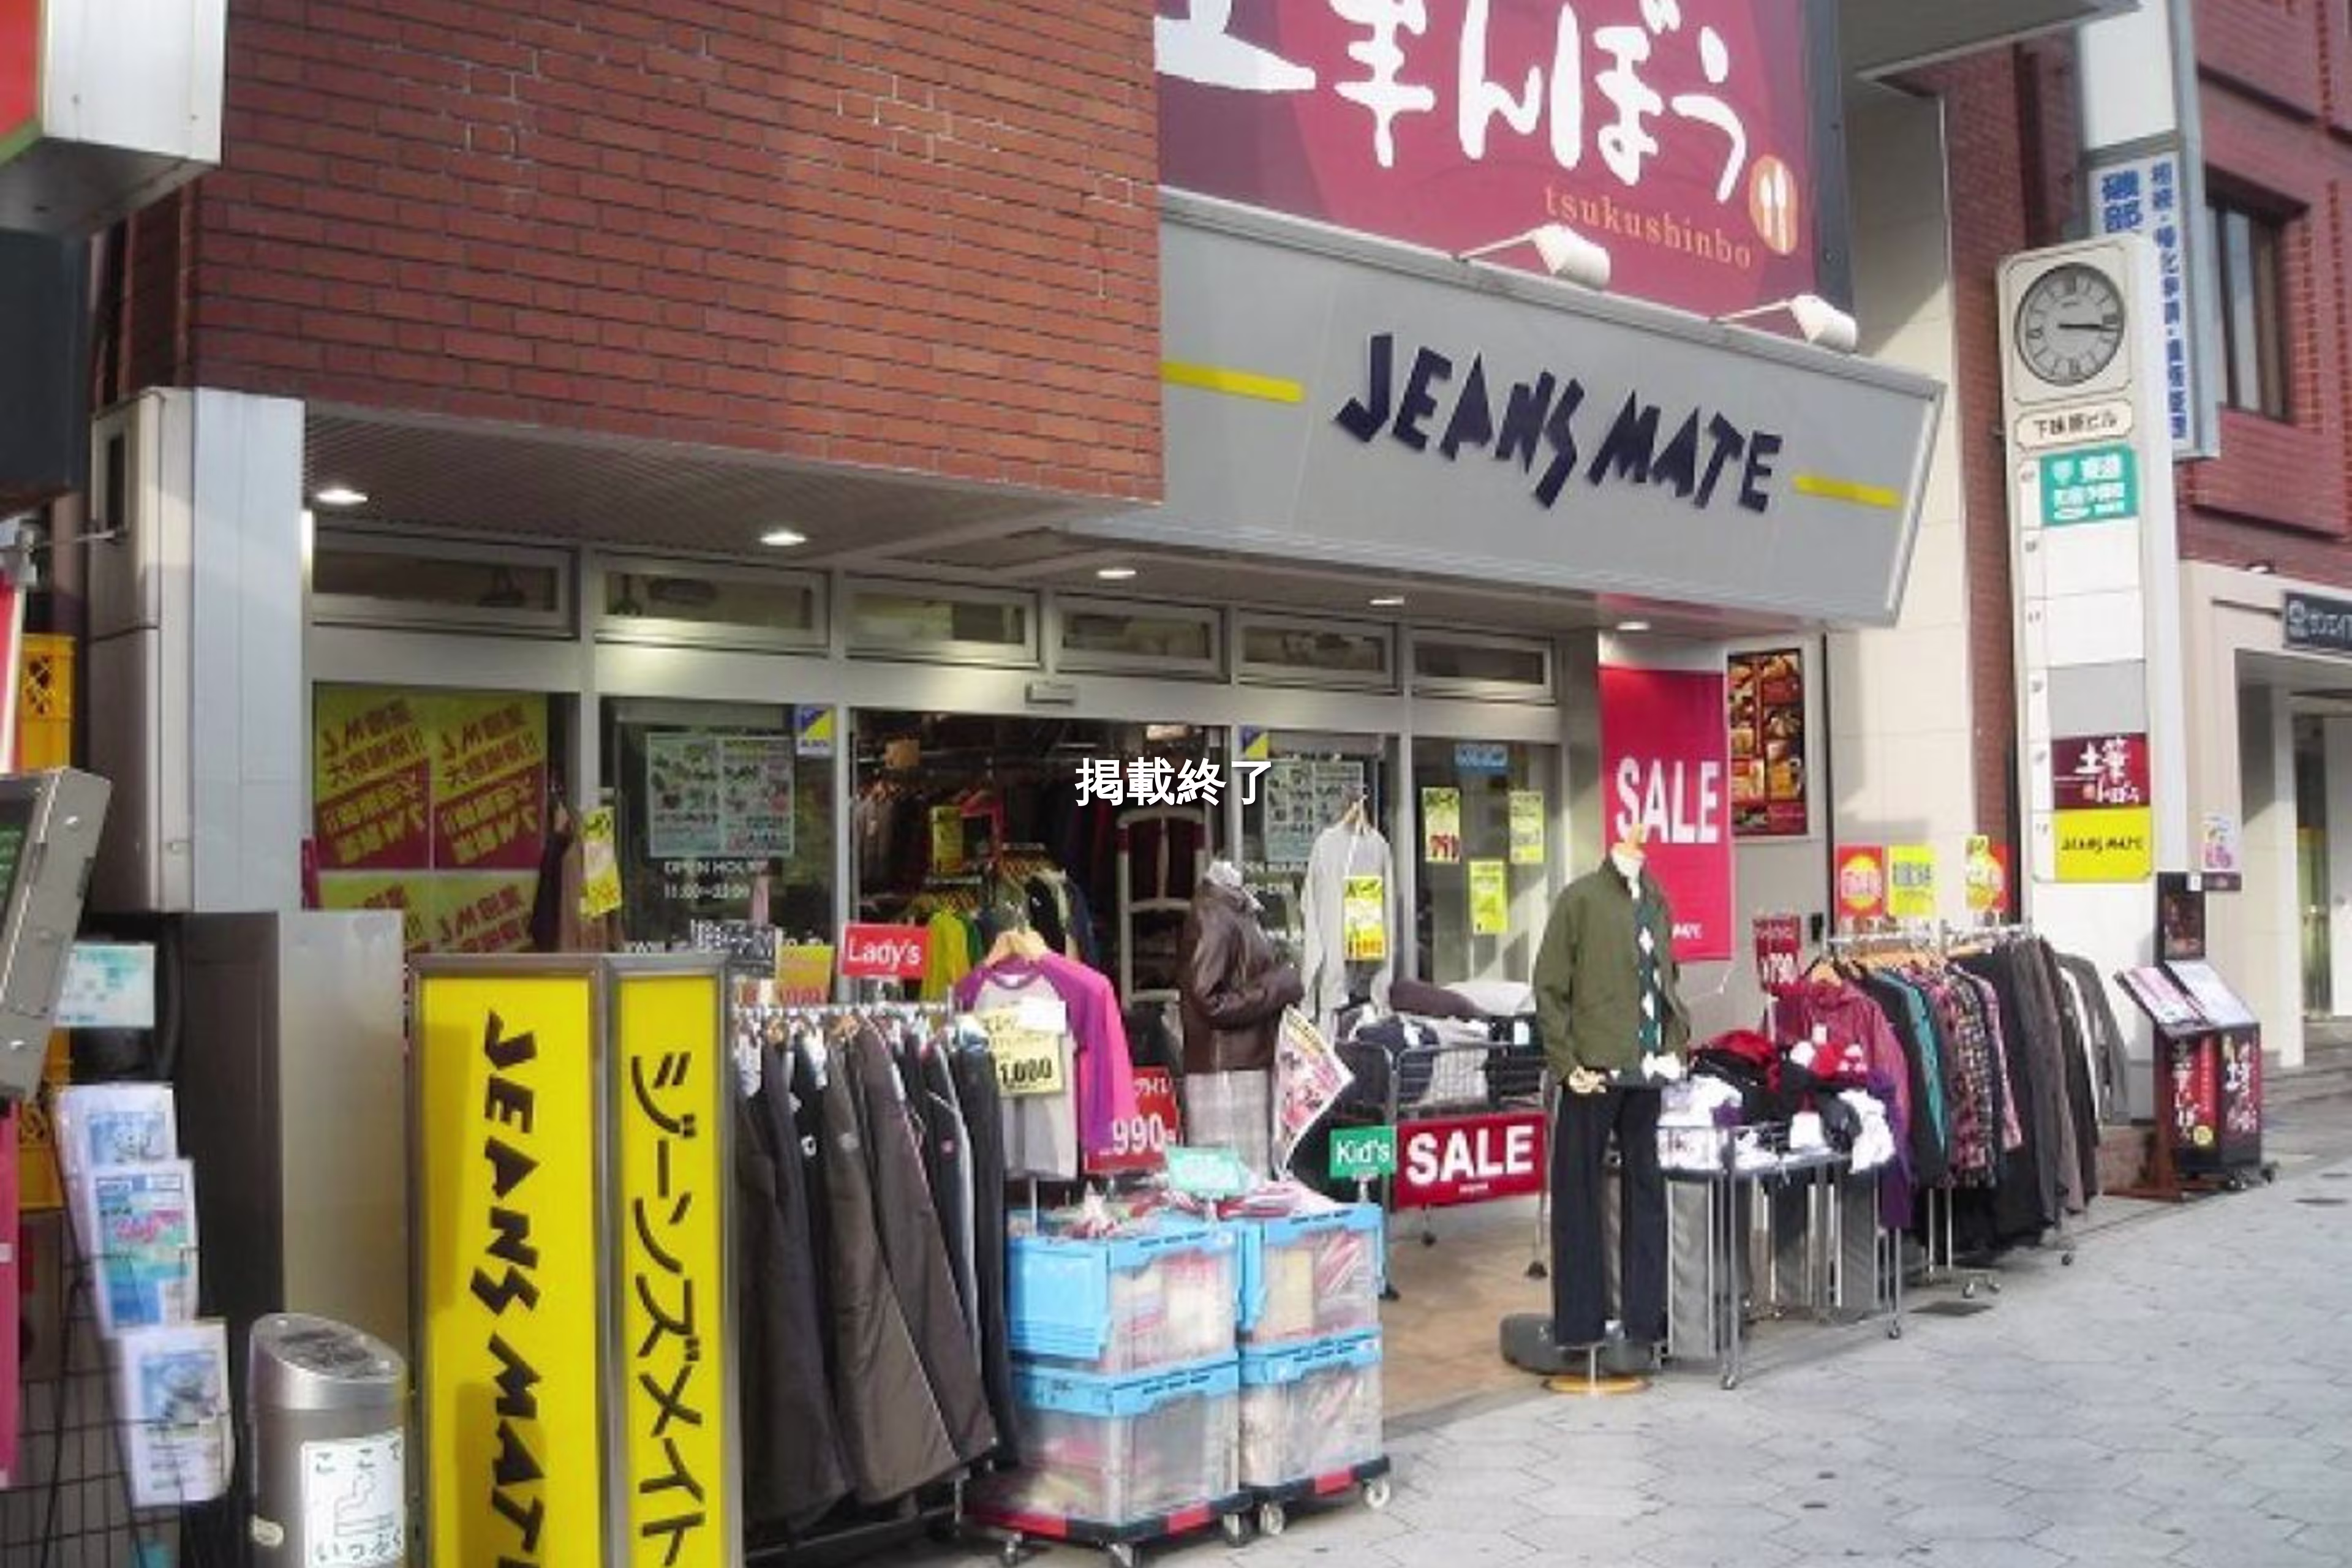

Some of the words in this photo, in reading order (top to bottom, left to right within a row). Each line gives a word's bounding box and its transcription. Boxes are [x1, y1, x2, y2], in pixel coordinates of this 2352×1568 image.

[1545, 185, 1752, 270] tsukushinbo
[1333, 333, 1585, 511] JEANS
[1587, 390, 1783, 513] MATE
[1615, 755, 1721, 845] SALE
[849, 935, 921, 973] Lady's
[470, 1009, 540, 1317] JEANS
[1335, 1138, 1391, 1165] Kid's
[1406, 1125, 1534, 1186] SALE
[631, 1051, 707, 1567] ジーンズメイト
[488, 1332, 545, 1568] MAT
